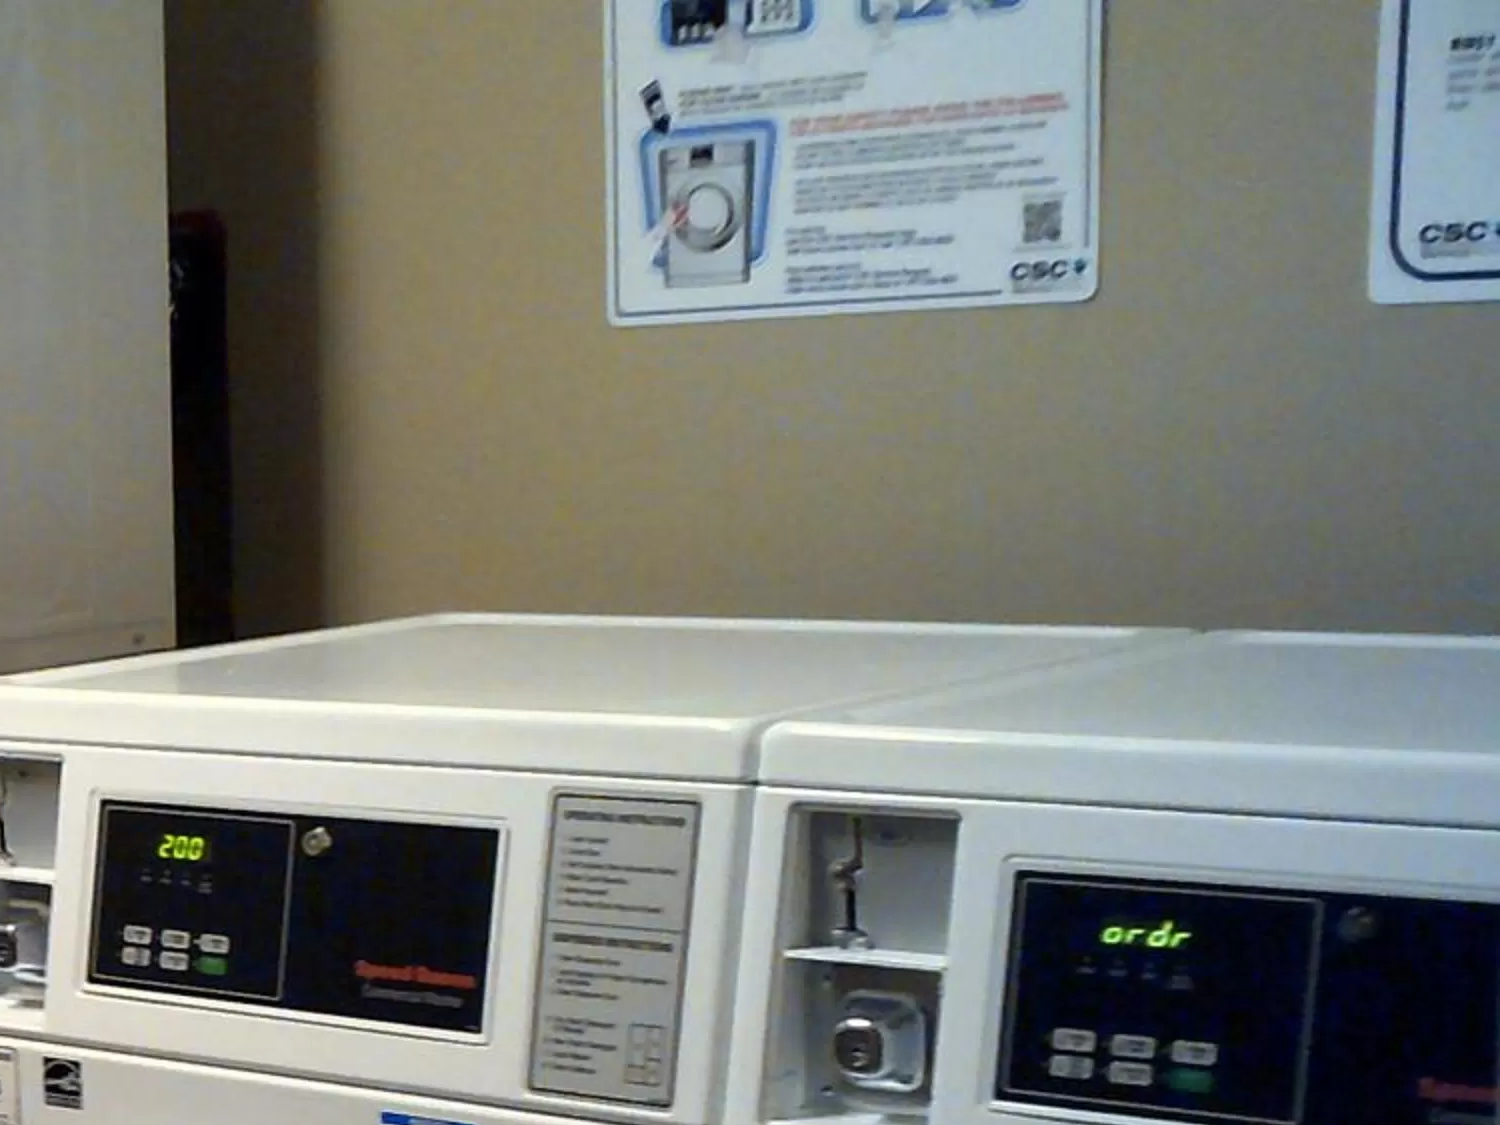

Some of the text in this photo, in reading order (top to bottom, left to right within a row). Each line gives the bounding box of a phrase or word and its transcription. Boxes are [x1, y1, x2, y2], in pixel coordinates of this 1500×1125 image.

[1418, 221, 1487, 243] CSC
[1010, 260, 1068, 281] CSC
[158, 833, 204, 861] 200
[1101, 920, 1192, 948] ordr
